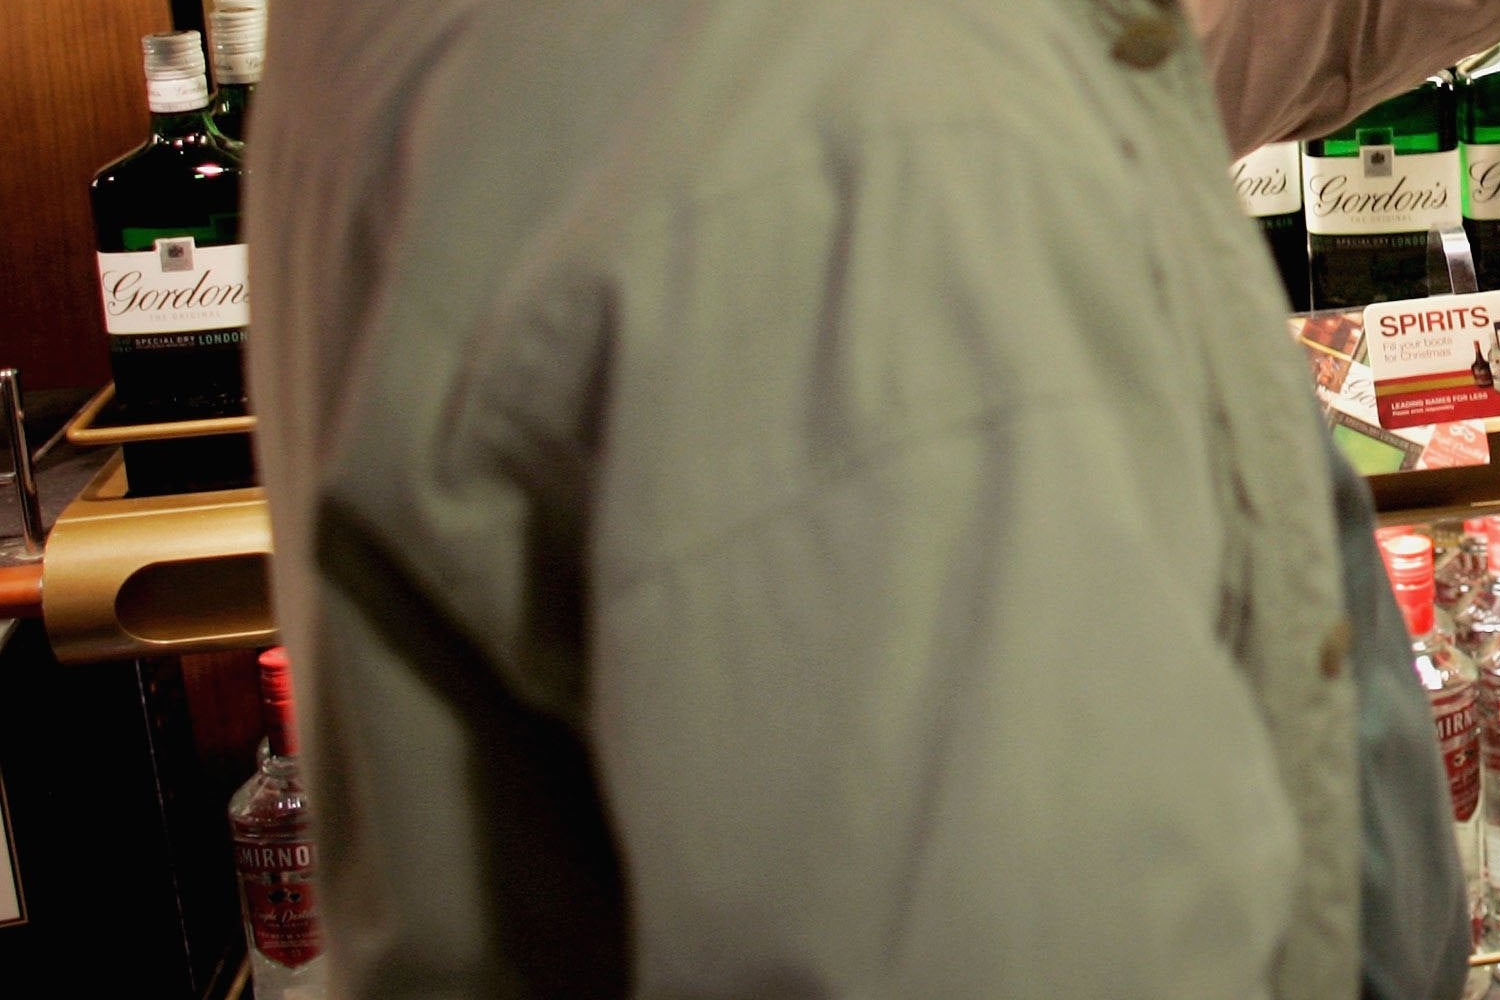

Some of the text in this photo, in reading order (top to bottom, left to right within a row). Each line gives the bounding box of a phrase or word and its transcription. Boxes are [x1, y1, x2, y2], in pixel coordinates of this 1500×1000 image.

[1233, 164, 1288, 197] on's
[1310, 175, 1448, 217] Gordon's
[103, 269, 249, 316] Gordon
[1380, 306, 1490, 337] SPIRITS
[240, 845, 311, 868] MIRNO
